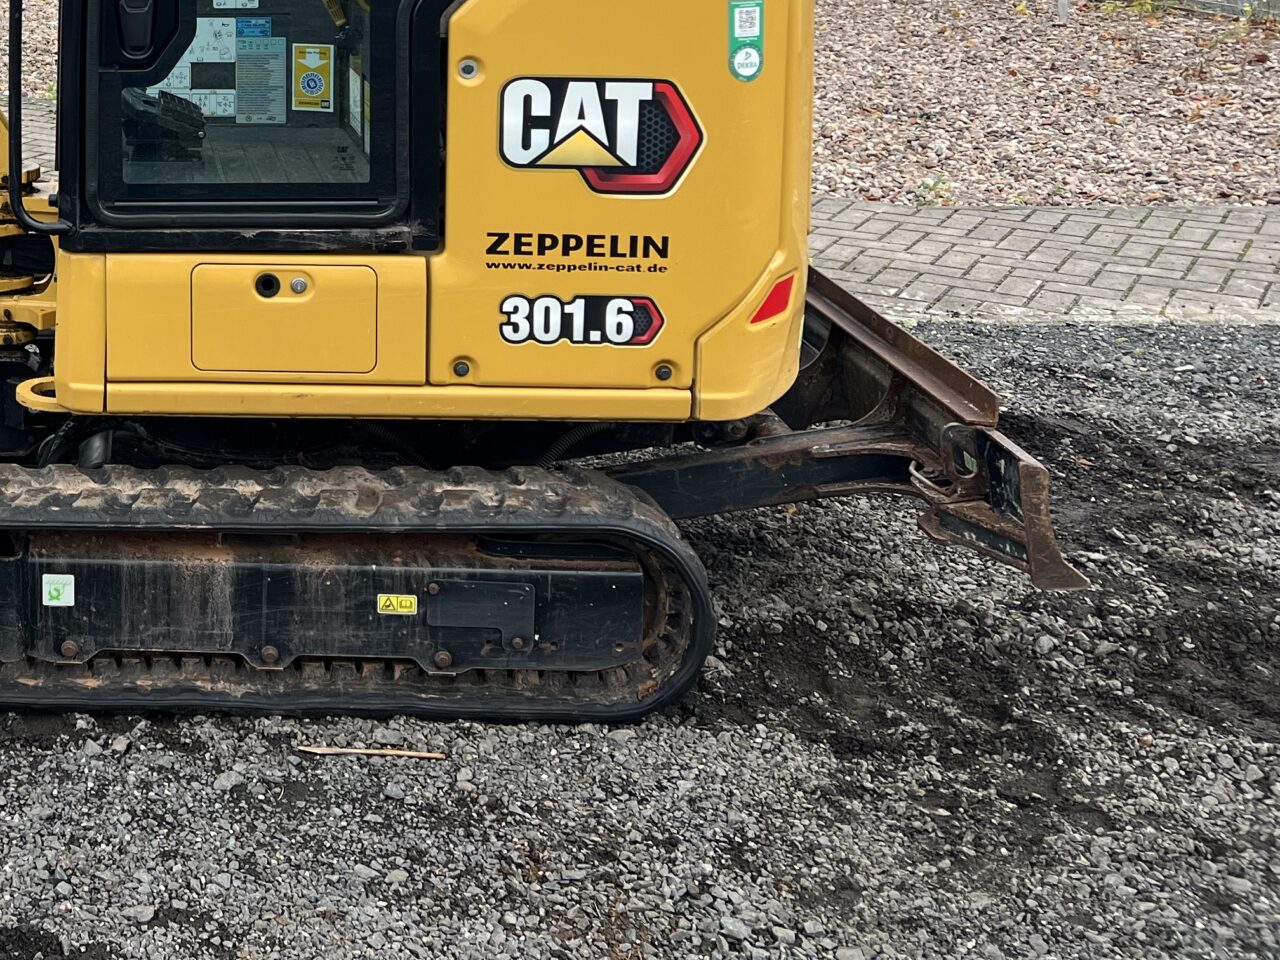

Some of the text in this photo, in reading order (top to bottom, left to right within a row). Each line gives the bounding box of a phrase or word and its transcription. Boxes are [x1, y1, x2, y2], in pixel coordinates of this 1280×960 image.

[736, 61, 758, 69] DEKRA
[502, 79, 654, 167] CAT
[485, 232, 670, 259] ZEPPELIN
[485, 261, 668, 273] www.zeppelin-cat.de
[501, 296, 635, 344] 301.6
